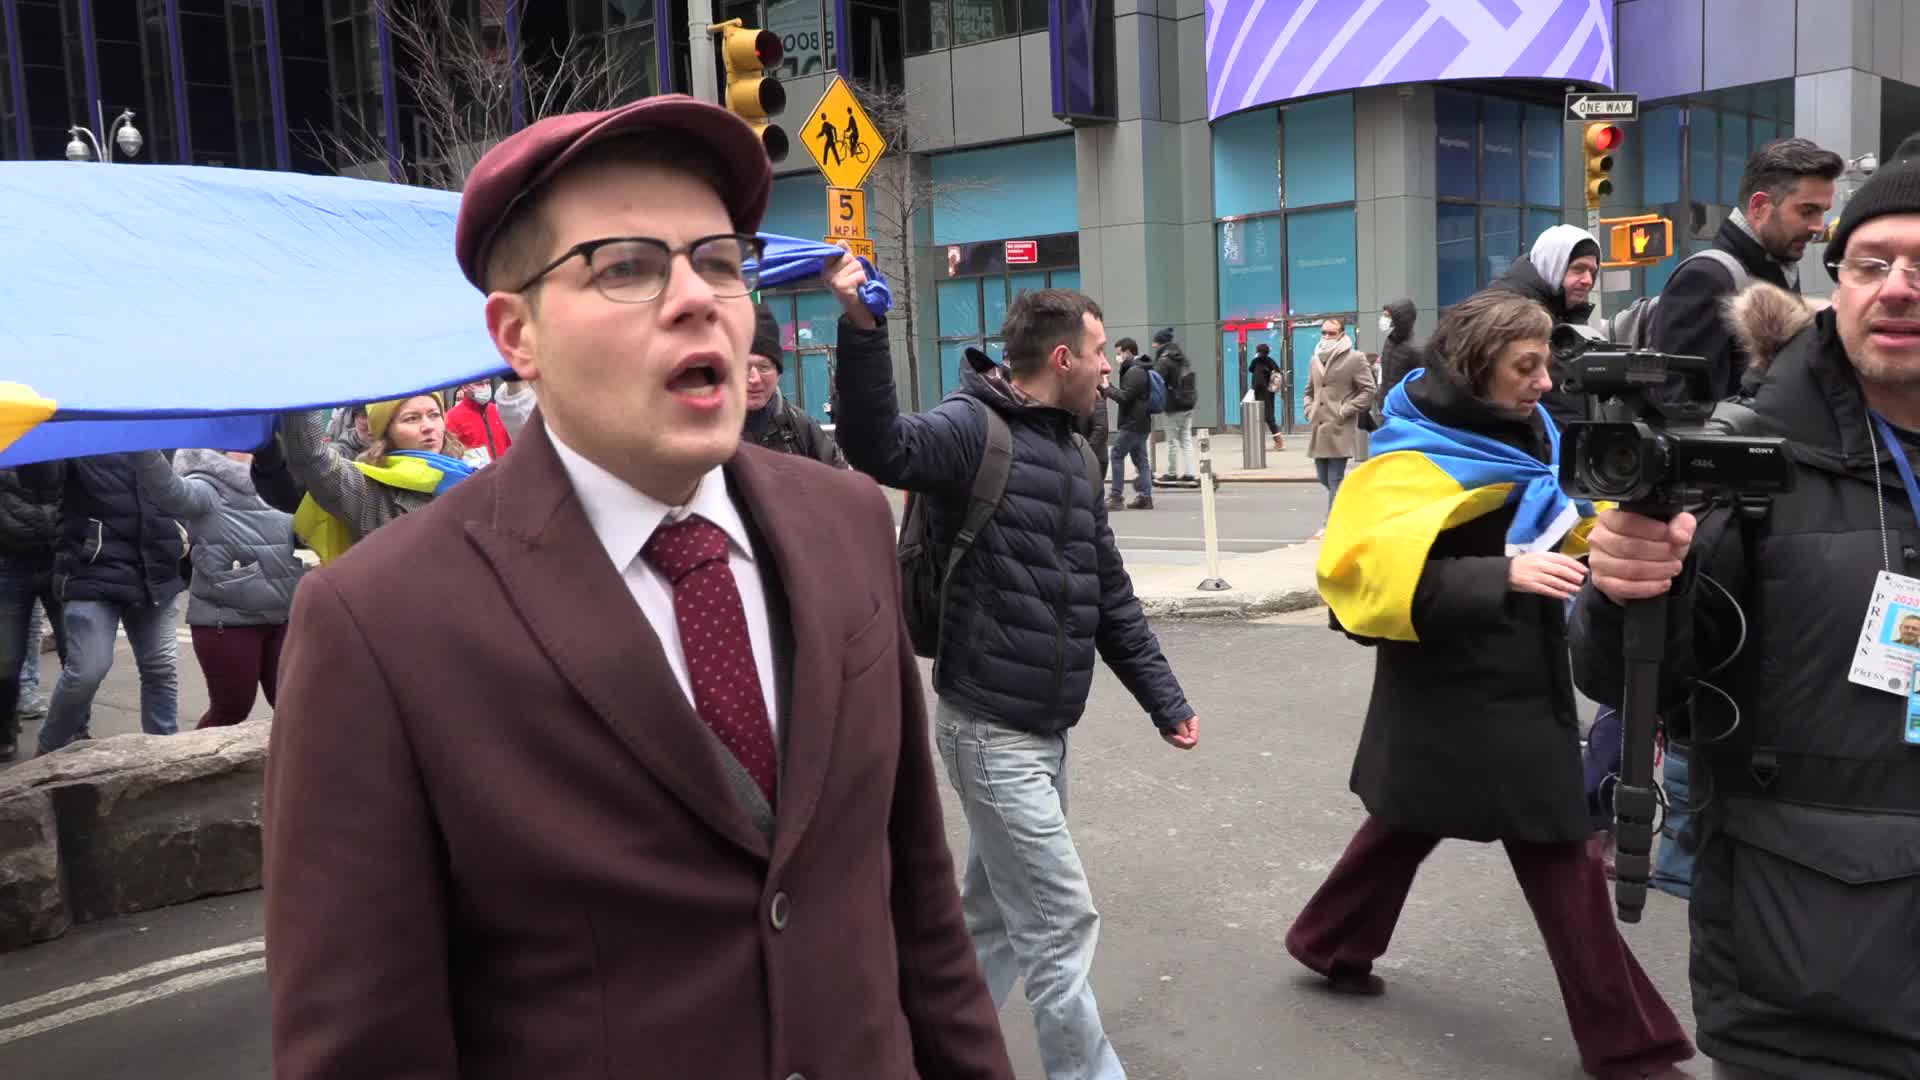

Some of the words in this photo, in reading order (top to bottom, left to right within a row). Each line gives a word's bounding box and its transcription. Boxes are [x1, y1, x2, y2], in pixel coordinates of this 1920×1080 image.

[1580, 102, 1601, 113] ONE
[1606, 102, 1627, 113] WAY
[840, 195, 853, 220] 5
[856, 244, 871, 255] THE
[1854, 667, 1885, 681] PRESS
